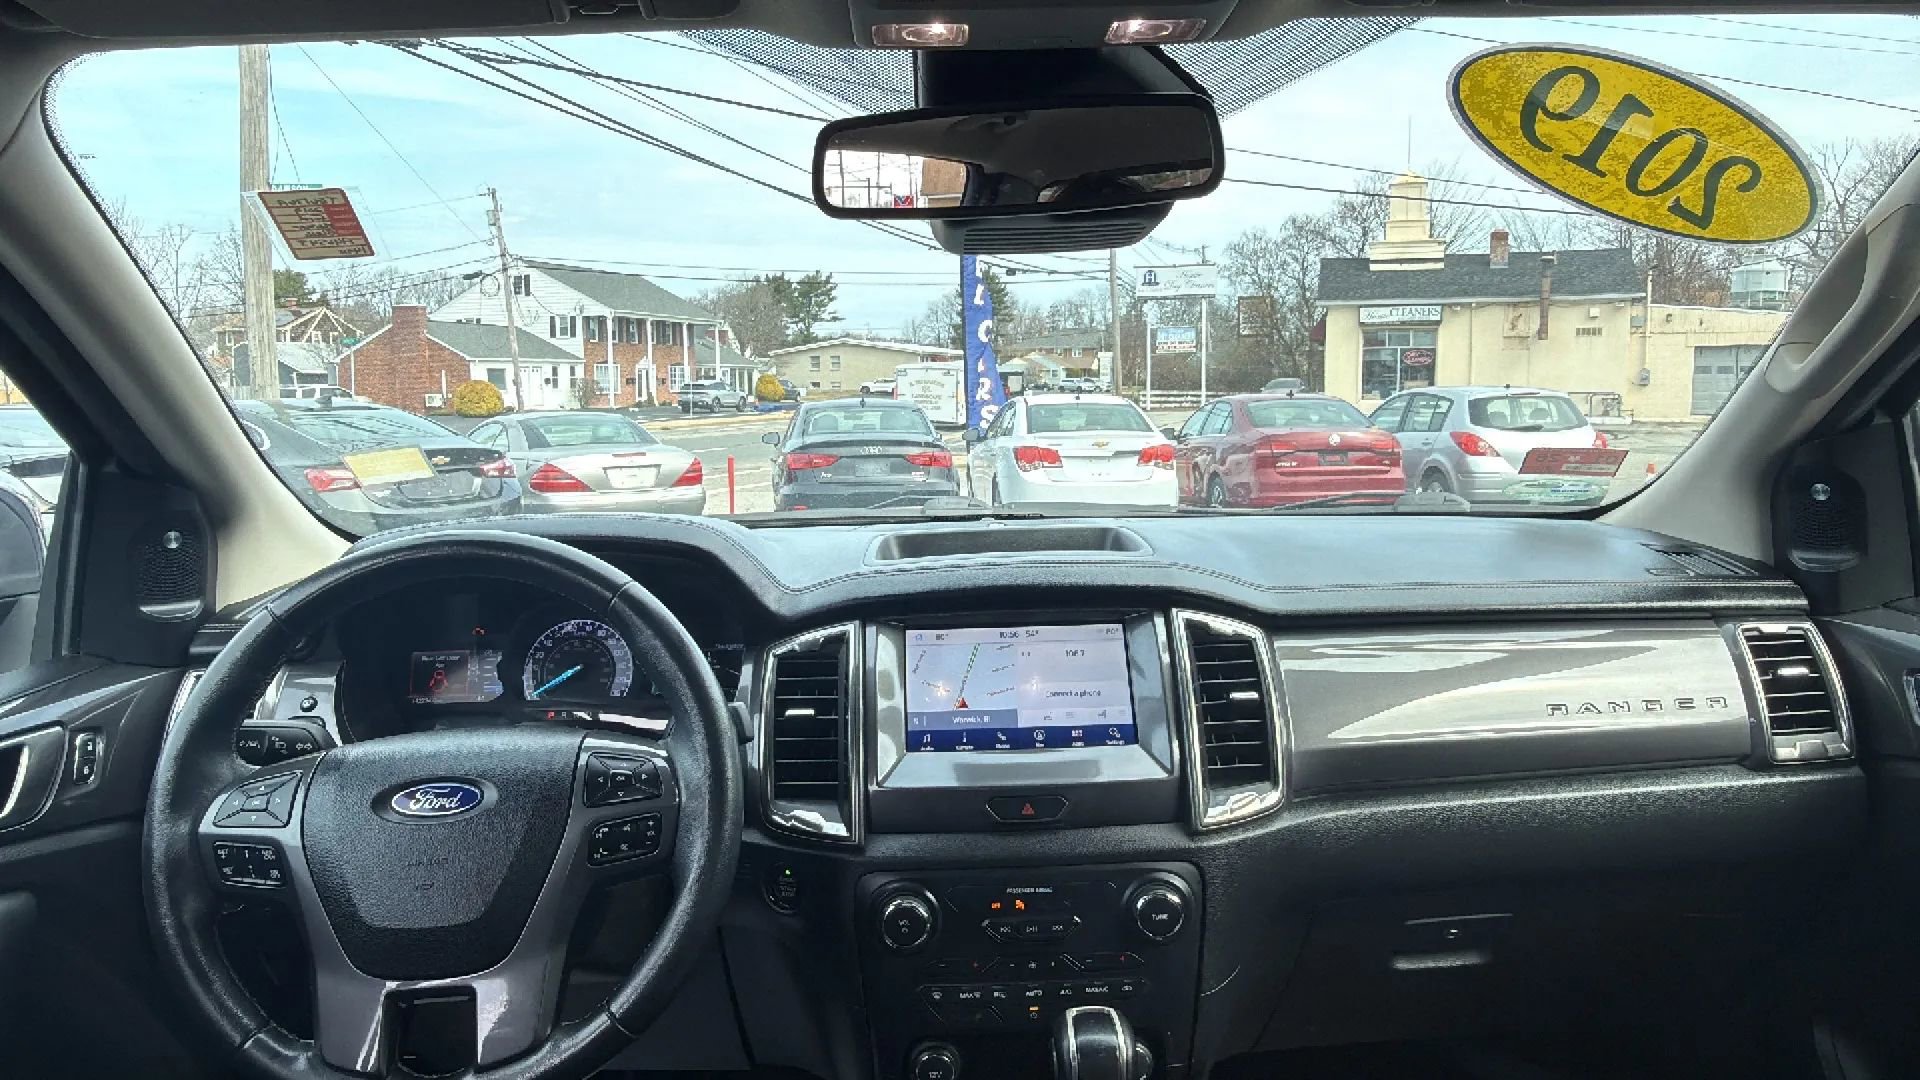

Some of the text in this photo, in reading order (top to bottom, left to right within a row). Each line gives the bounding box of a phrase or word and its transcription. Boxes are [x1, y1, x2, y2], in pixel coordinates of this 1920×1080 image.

[1546, 696, 1728, 716] RANGER
[408, 786, 464, 809] Ford
[1151, 913, 1169, 921] TUNE
